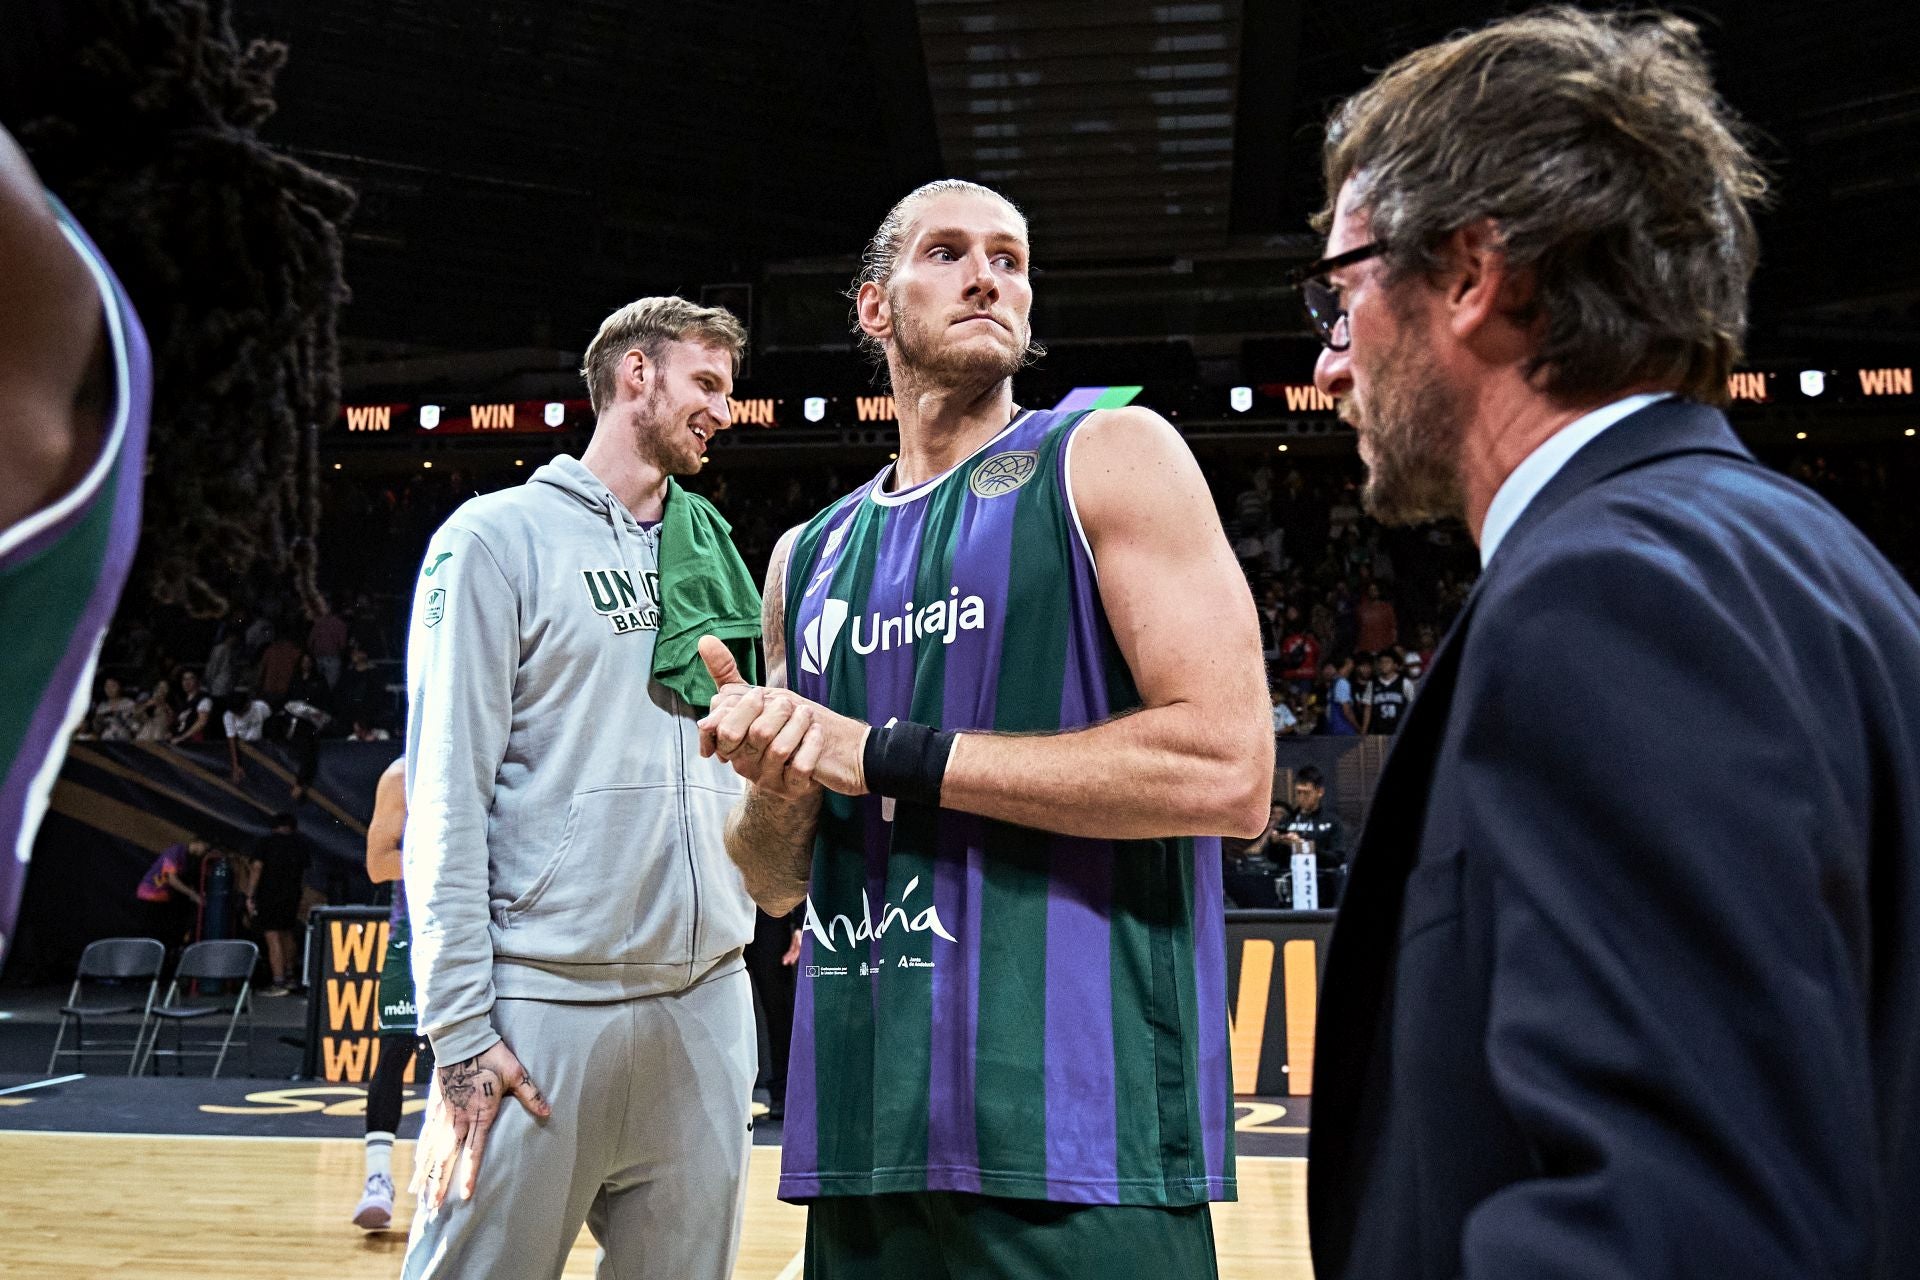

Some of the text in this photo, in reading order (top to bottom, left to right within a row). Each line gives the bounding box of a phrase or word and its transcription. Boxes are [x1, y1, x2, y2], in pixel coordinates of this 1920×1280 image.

[1858, 367, 1913, 396] WIN
[1285, 385, 1334, 411] WIN
[347, 406, 391, 431] WIN
[471, 404, 515, 429] WIN
[728, 399, 774, 424] WIN
